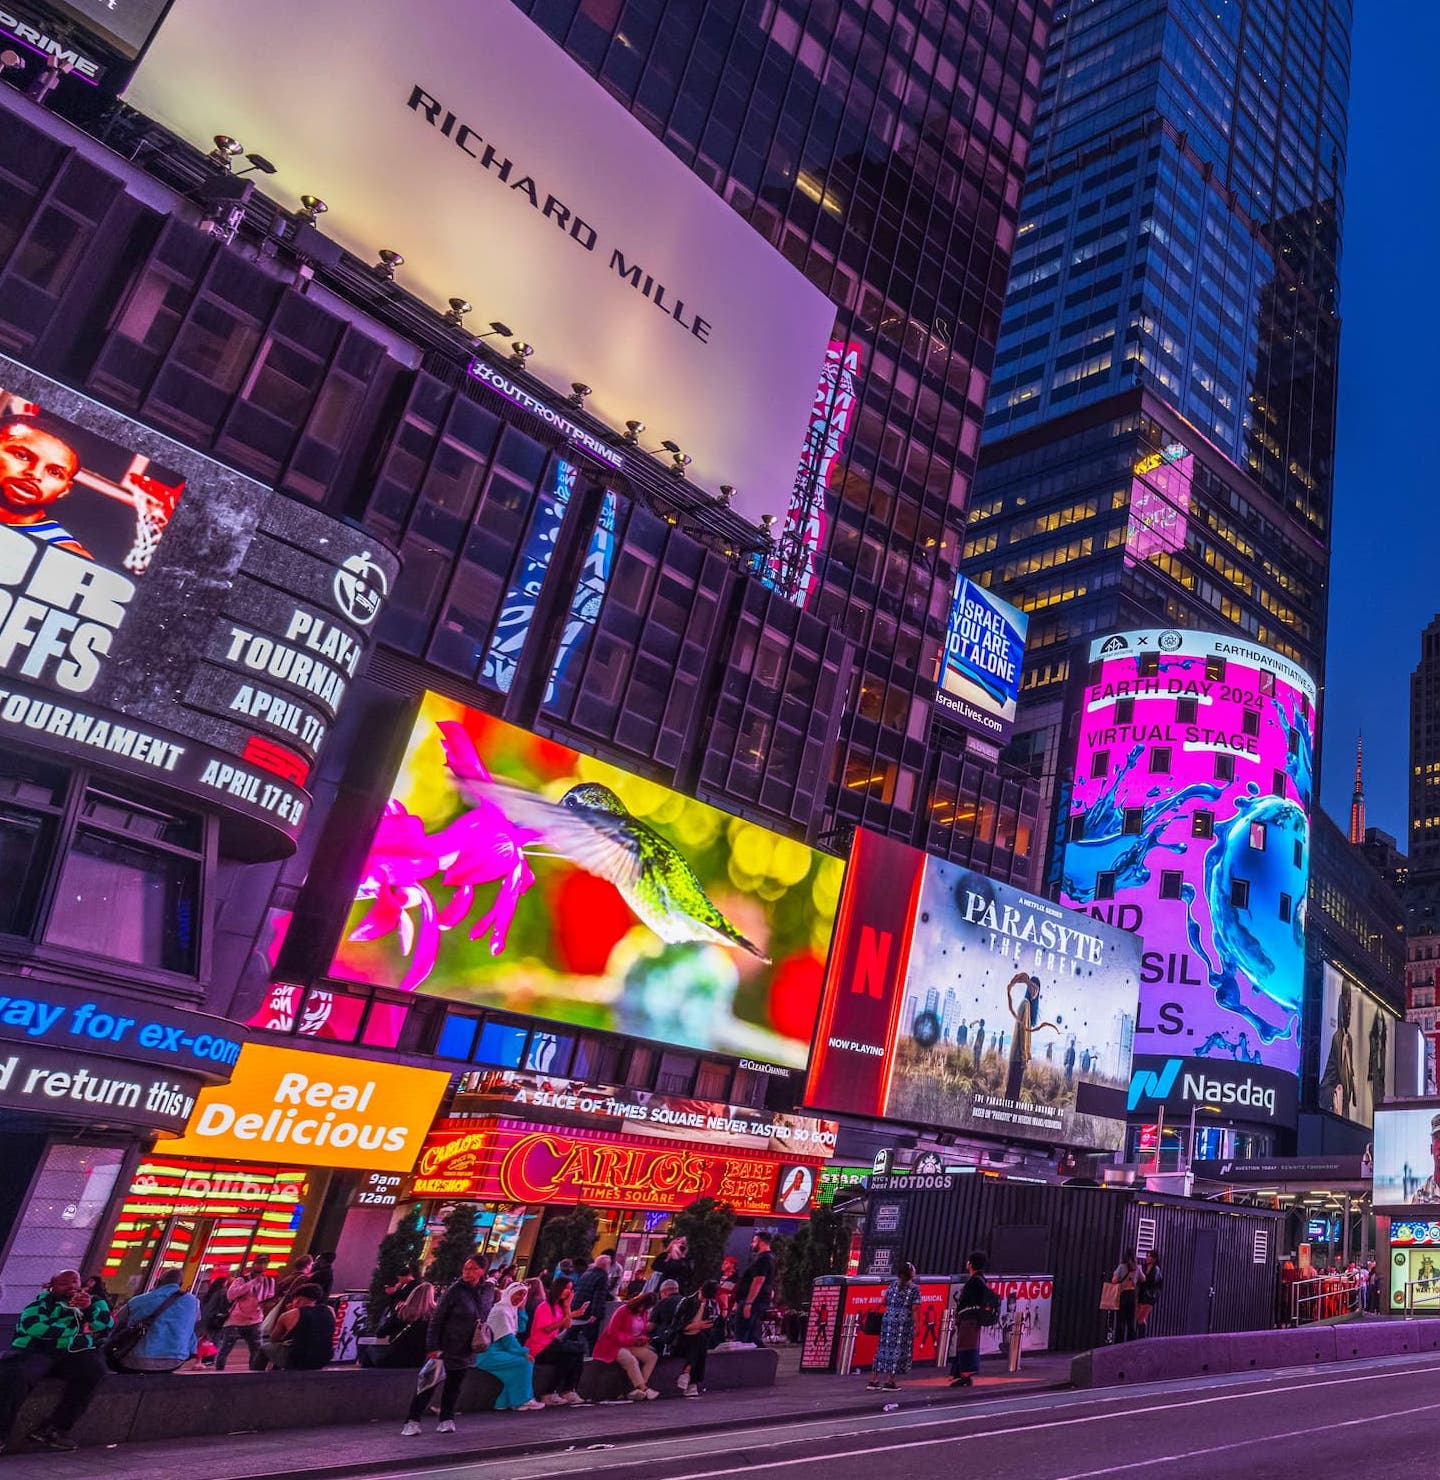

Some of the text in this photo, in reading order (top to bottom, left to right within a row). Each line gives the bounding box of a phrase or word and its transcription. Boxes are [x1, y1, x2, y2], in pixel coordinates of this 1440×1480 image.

[406, 84, 712, 344] RICHARD MILLE
[473, 362, 623, 468] #OUTFRONTPRIME
[959, 586, 1007, 639] ISRAEL
[0, 588, 113, 692] FFS
[953, 611, 1011, 661] YOU ARE
[969, 645, 1017, 684] ALONE
[229, 684, 303, 740] APRIL
[935, 690, 1003, 733] IsraelLives.com
[1091, 677, 1265, 710] EARTH DAY 2024
[1087, 724, 1259, 756] VIRTUAL STAGE
[200, 758, 263, 805] APRIL
[961, 890, 1105, 966] PARASYTE
[989, 932, 1078, 978] THE GREY
[69, 1002, 136, 1043] for
[828, 1036, 885, 1058] NOW PLAYING
[22, 1067, 142, 1108] return
[146, 1081, 184, 1119] this
[274, 1072, 376, 1113] Real
[1182, 1073, 1276, 1117] Nasdaq
[196, 1102, 409, 1153] Delicious
[512, 1090, 528, 1104] A
[532, 1092, 576, 1111] SLICE
[579, 1098, 603, 1113] OF
[604, 1100, 649, 1120] TIMES
[650, 1108, 706, 1127] SQUARE
[706, 1116, 749, 1134] NEVER
[750, 1121, 791, 1139] TASTED
[793, 1127, 809, 1141] SO
[420, 1133, 487, 1176] CARLO'S
[500, 1132, 713, 1204] CARLO'S
[725, 1160, 773, 1180] BAKE
[358, 1192, 397, 1205] 12am
[369, 1173, 401, 1186] 9am
[375, 1185, 387, 1193] to
[581, 1186, 675, 1204] TIMES SQUARE
[720, 1177, 770, 1198] SHOP
[889, 1175, 953, 1189] HOTDOGS
